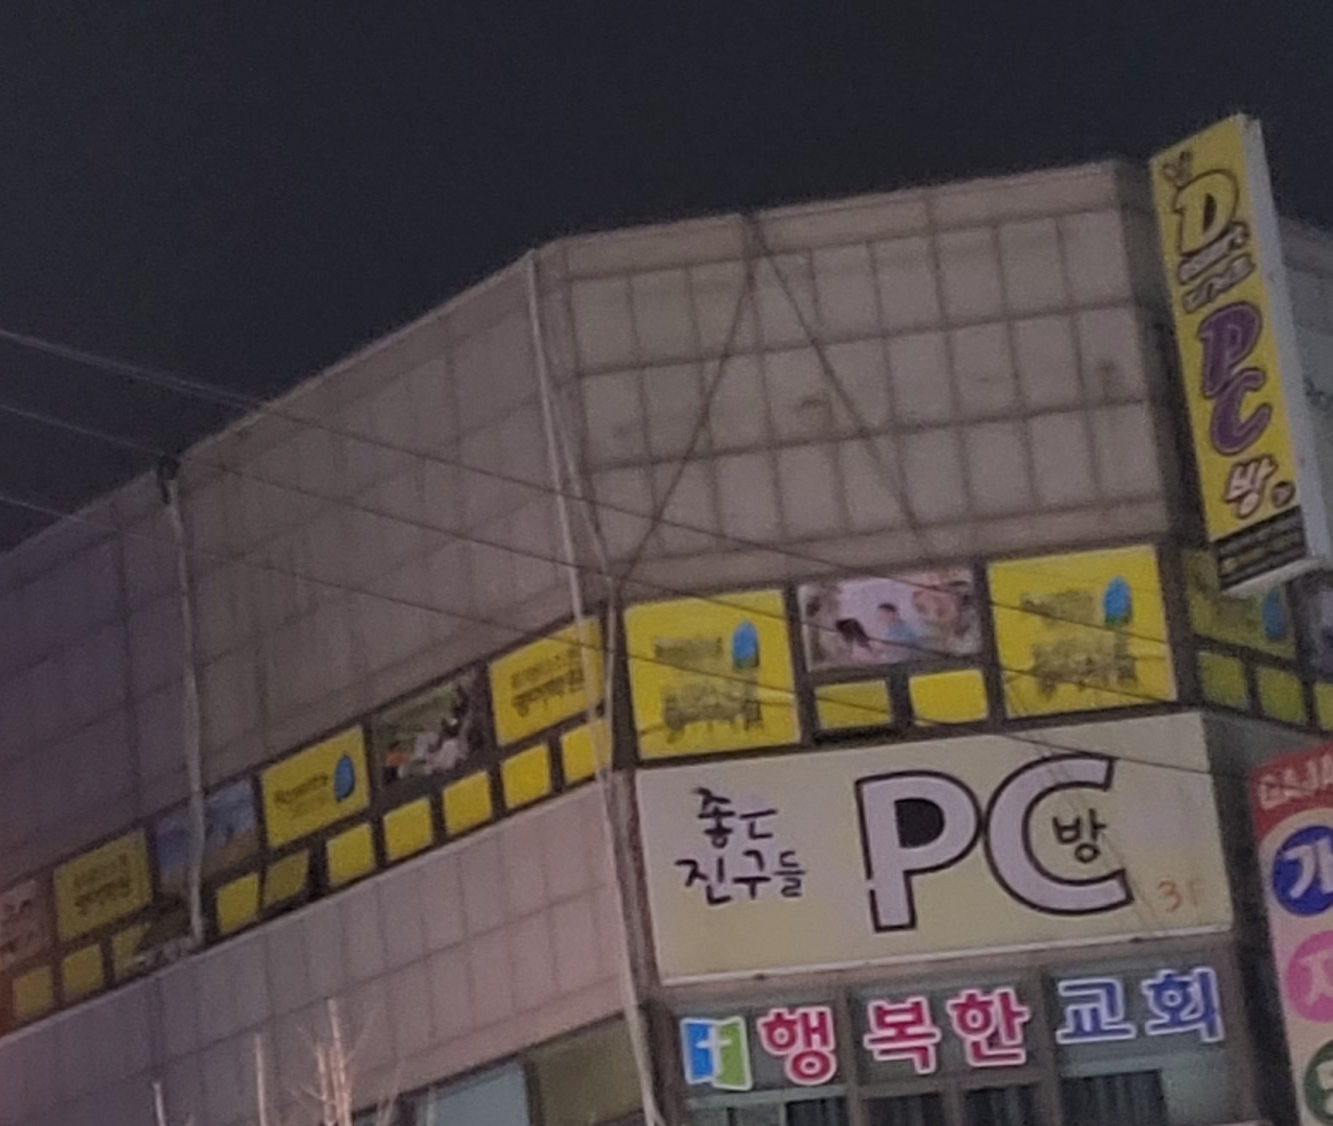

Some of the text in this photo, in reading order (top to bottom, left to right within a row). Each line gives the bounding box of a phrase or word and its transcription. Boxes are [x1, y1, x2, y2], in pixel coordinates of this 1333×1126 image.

[689, 787, 779, 849] 좋은
[756, 967, 1226, 1086] 행복한 교회
